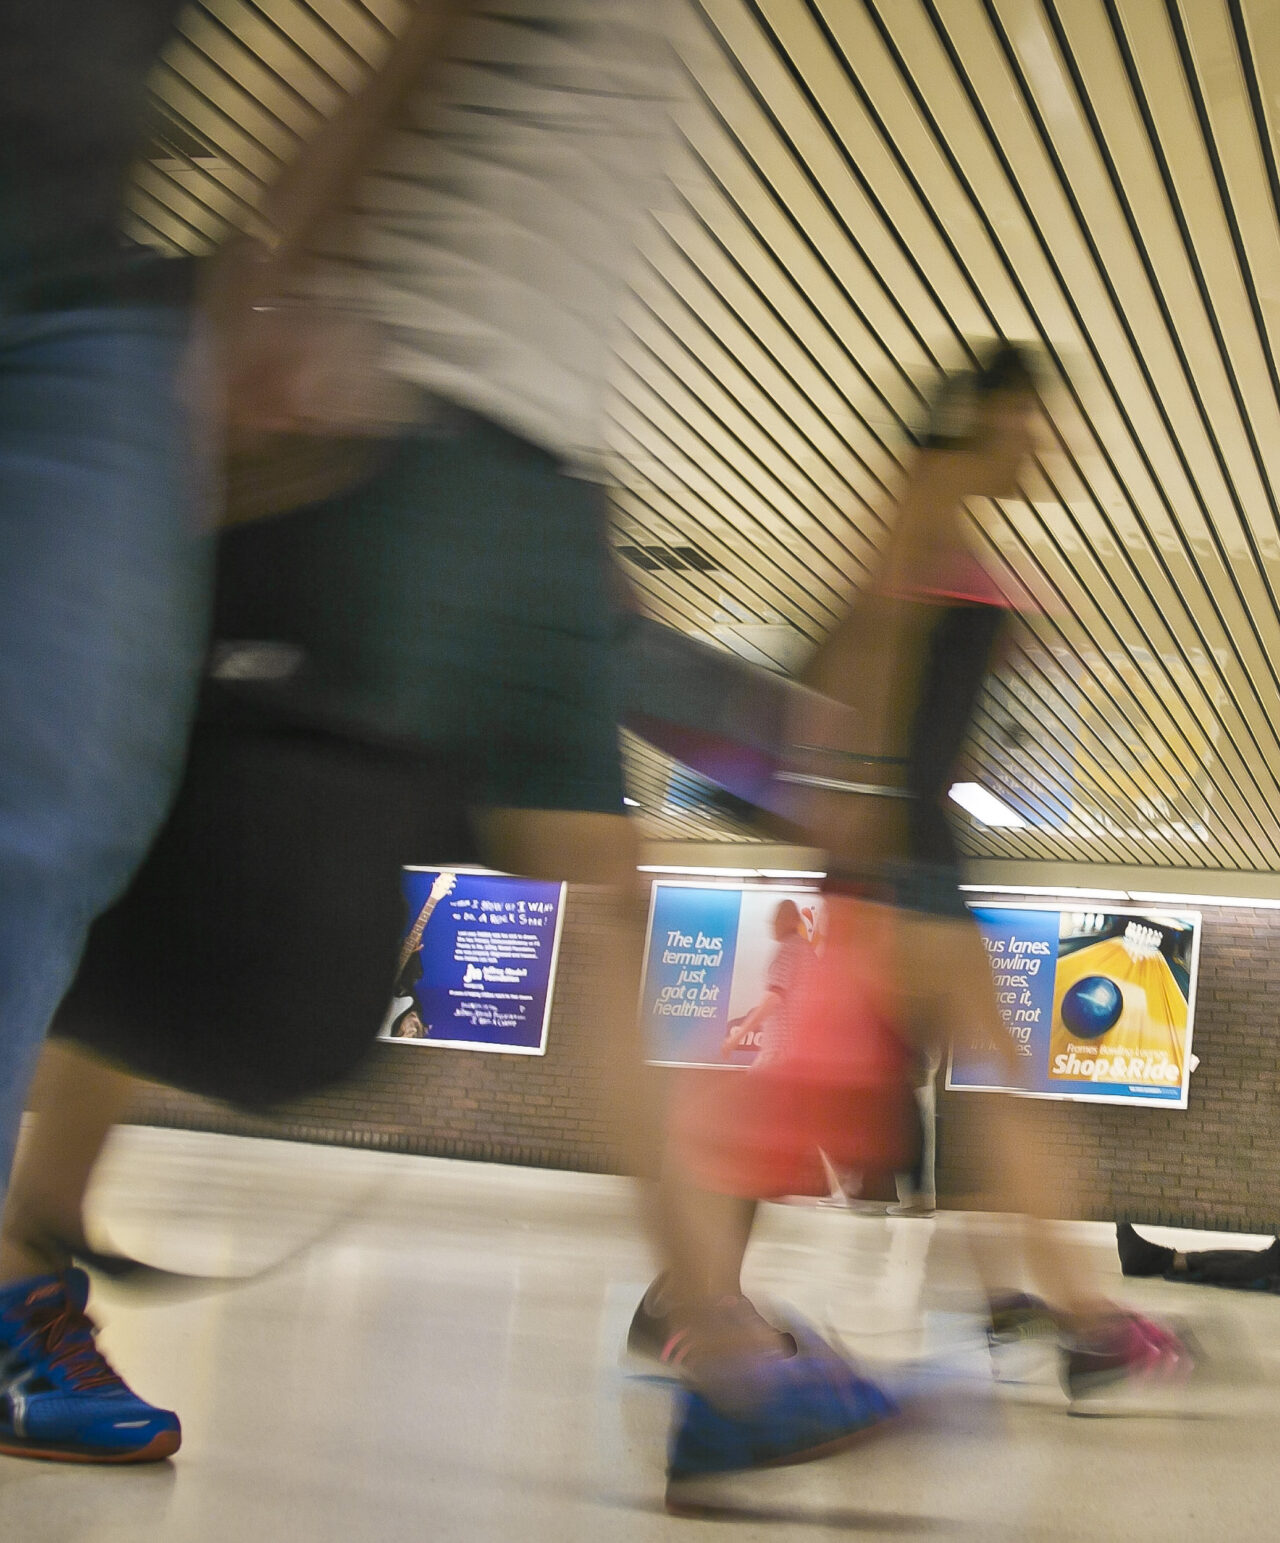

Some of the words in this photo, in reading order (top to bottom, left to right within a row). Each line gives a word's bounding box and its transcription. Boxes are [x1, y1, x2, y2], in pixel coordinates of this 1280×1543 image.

[517, 901, 525, 913] I
[667, 930, 693, 948] The
[695, 931, 723, 950] bus
[1008, 936, 1051, 955] lanes.
[662, 949, 723, 967] terminal
[987, 954, 1041, 976] owling
[676, 966, 707, 985] just
[993, 974, 1029, 988] anes.
[661, 985, 686, 1002] got
[687, 987, 698, 1000] a
[700, 984, 720, 1001] bit
[994, 992, 1017, 1004] ce
[1020, 988, 1032, 1007] it,
[653, 998, 717, 1018] healthier.
[1015, 1007, 1042, 1022] not
[1052, 1053, 1180, 1083] Shop&Ride
